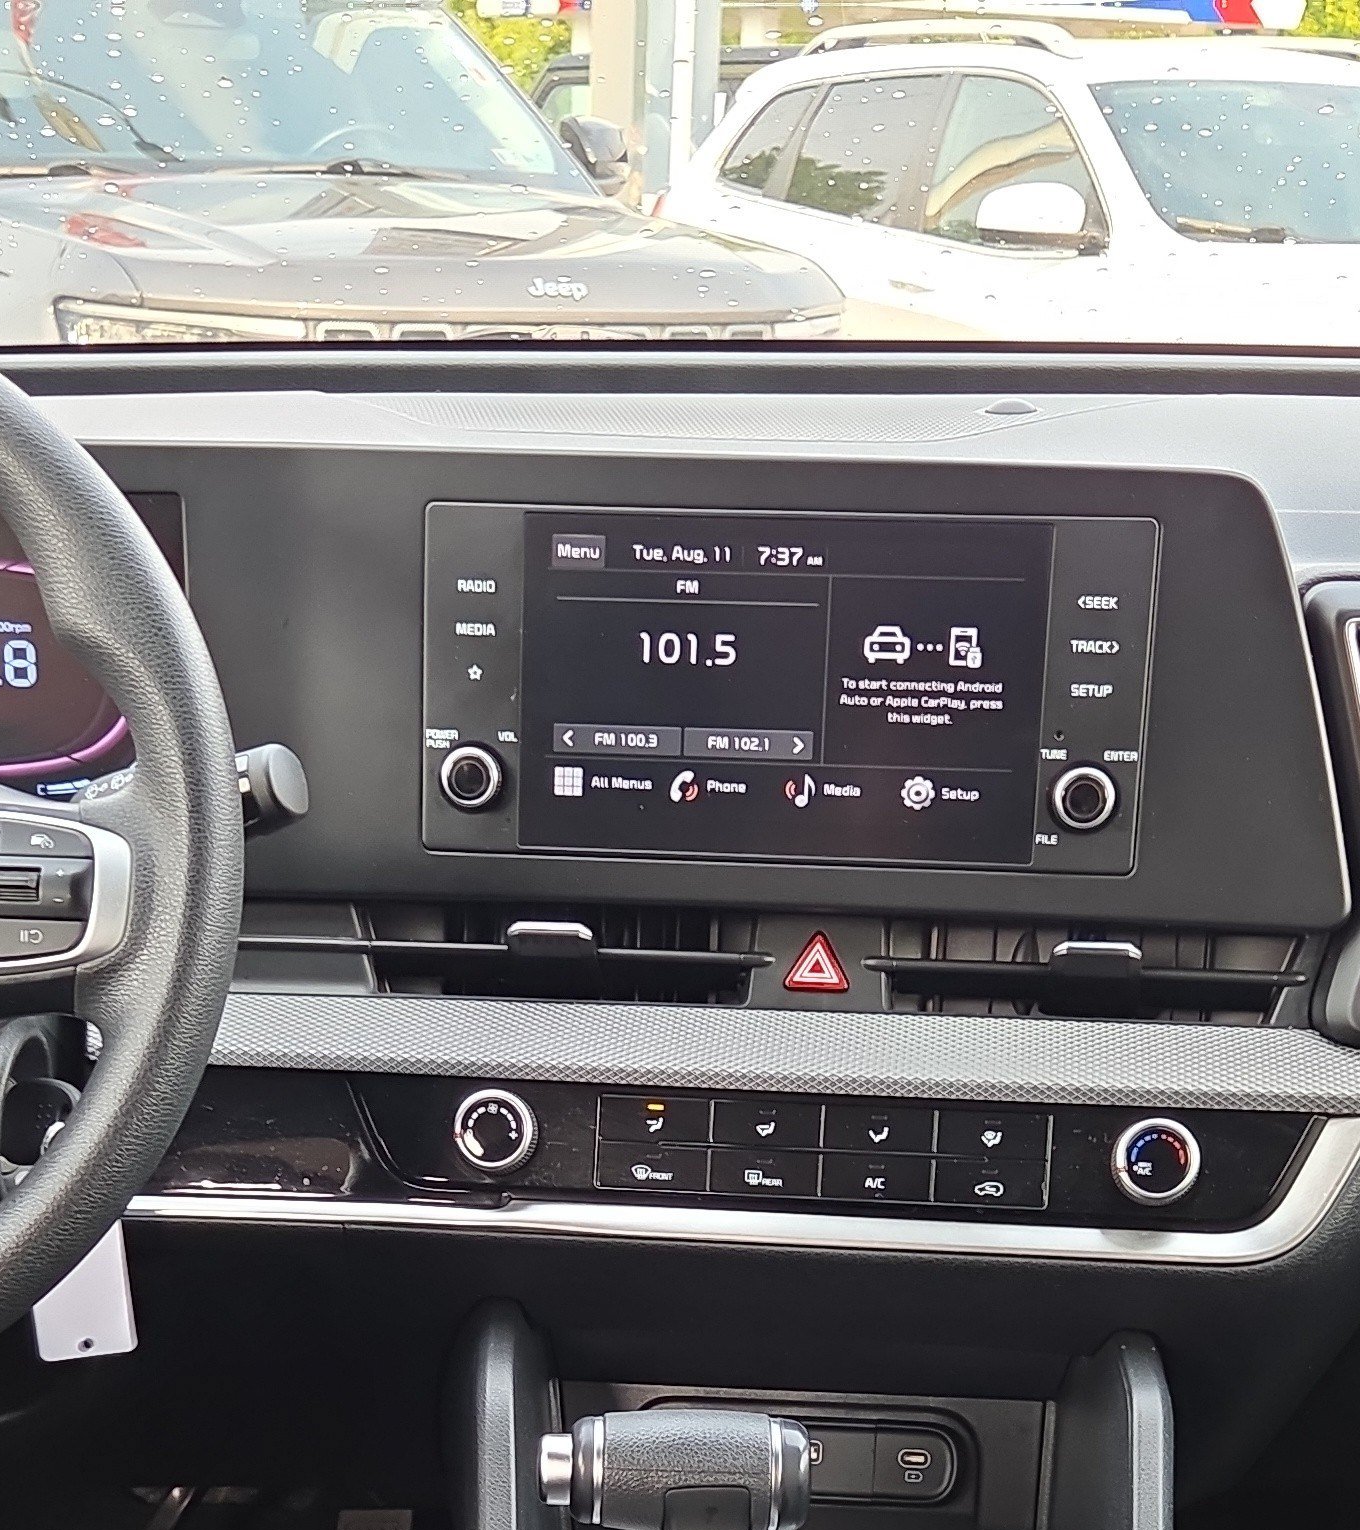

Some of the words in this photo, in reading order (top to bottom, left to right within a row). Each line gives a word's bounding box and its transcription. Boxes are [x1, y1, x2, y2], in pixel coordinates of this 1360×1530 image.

[526, 276, 589, 301] Jeep
[557, 543, 601, 560] Menu
[671, 545, 709, 564] Aug.
[713, 546, 732, 563] 11
[757, 546, 804, 567] 7:37
[806, 555, 824, 567] AM
[457, 579, 496, 593] RADIO
[676, 579, 700, 595] FM
[455, 622, 496, 636] MEDIA
[639, 631, 737, 667] 101.5
[841, 677, 856, 690] To
[858, 678, 888, 691] start
[889, 680, 955, 694] connecting
[956, 681, 1003, 693] Android
[1070, 684, 1113, 697] SETUP
[839, 694, 868, 706] Auto
[869, 697, 884, 706] or
[885, 696, 919, 709] Apple
[969, 699, 1003, 711] press
[887, 712, 910, 724] this
[911, 713, 953, 726] widget.
[425, 728, 459, 740] POWER
[497, 731, 519, 742] VOL
[594, 732, 616, 746] FM
[620, 733, 658, 748] 100.3
[426, 739, 450, 749] PUSH
[707, 736, 729, 750] FM
[733, 737, 770, 752] 102.1
[1040, 749, 1068, 760] TUNE
[1103, 750, 1139, 761] ENTER
[591, 775, 609, 789] All
[611, 776, 653, 791] Menus
[706, 779, 747, 794] Phone
[824, 783, 861, 797] Media
[941, 787, 979, 802] Setup
[1035, 834, 1058, 845] FILE
[648, 1171, 674, 1182] FRONT
[761, 1178, 783, 1188] REAR
[864, 1177, 886, 1190] A/C
